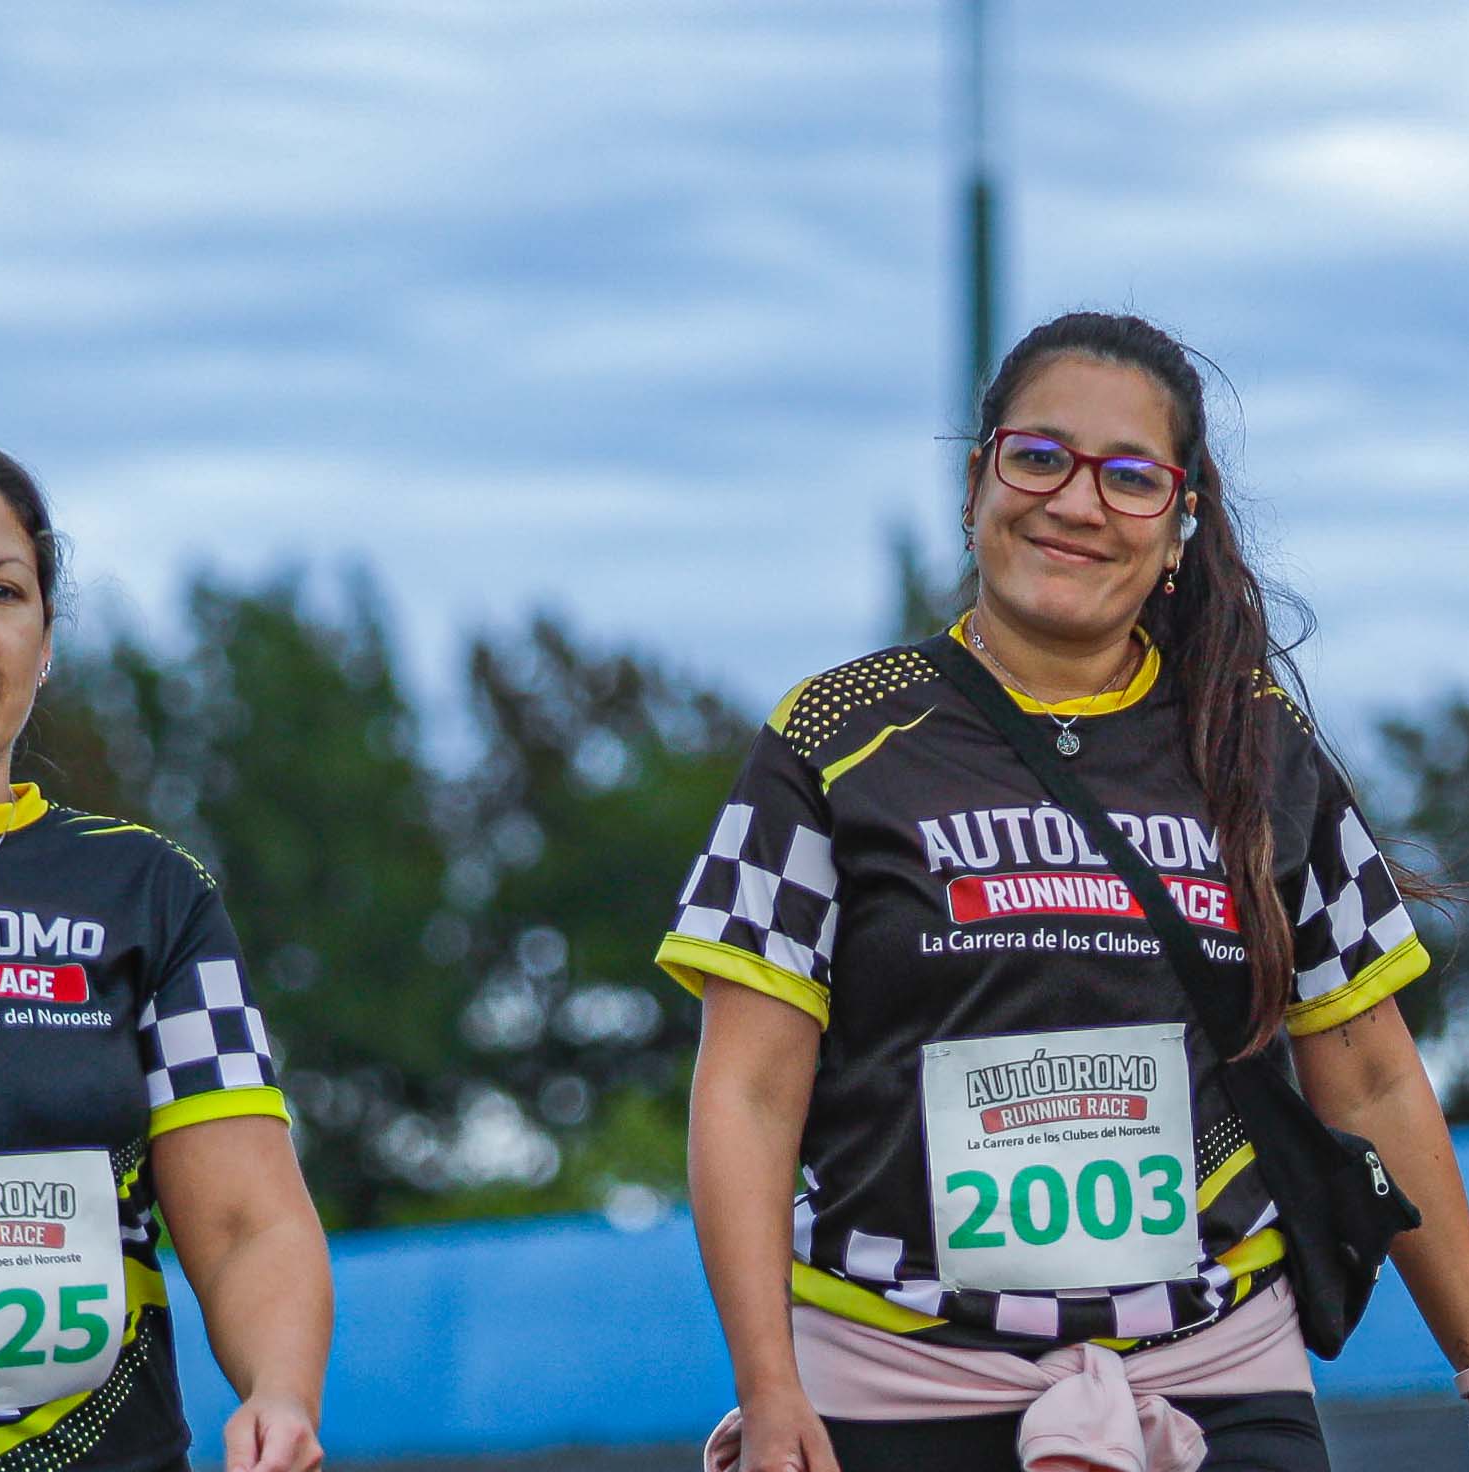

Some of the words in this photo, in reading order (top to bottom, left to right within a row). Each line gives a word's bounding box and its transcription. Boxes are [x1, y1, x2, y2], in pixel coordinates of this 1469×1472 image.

[918, 800, 1227, 877] AUTÓROM
[983, 876, 1131, 913] RUNNING
[1167, 880, 1227, 925] ACE
[922, 932, 943, 952] La
[949, 930, 1027, 950] Carrera
[1032, 927, 1057, 948] de
[1062, 928, 1090, 950] los
[1095, 931, 1161, 955] Clubes
[1202, 938, 1245, 961] Noro
[5, 1008, 34, 1025] del
[37, 1008, 112, 1026] Noroeste
[966, 1048, 1157, 1108] AUTÓDROMO
[1000, 1099, 1081, 1129] RUNNING
[1087, 1097, 1130, 1117] RACE
[967, 1139, 980, 1150] La
[983, 1136, 1024, 1149] Carrera
[1027, 1133, 1041, 1145] de
[1044, 1132, 1060, 1144] los
[1062, 1129, 1099, 1141] Clubes
[1101, 1126, 1117, 1138] del
[1118, 1124, 1161, 1136] Noroeste
[945, 1154, 1187, 1250] 2003
[0, 1224, 46, 1245] RACE
[16, 1254, 33, 1267] del
[34, 1252, 82, 1265] Noroeste
